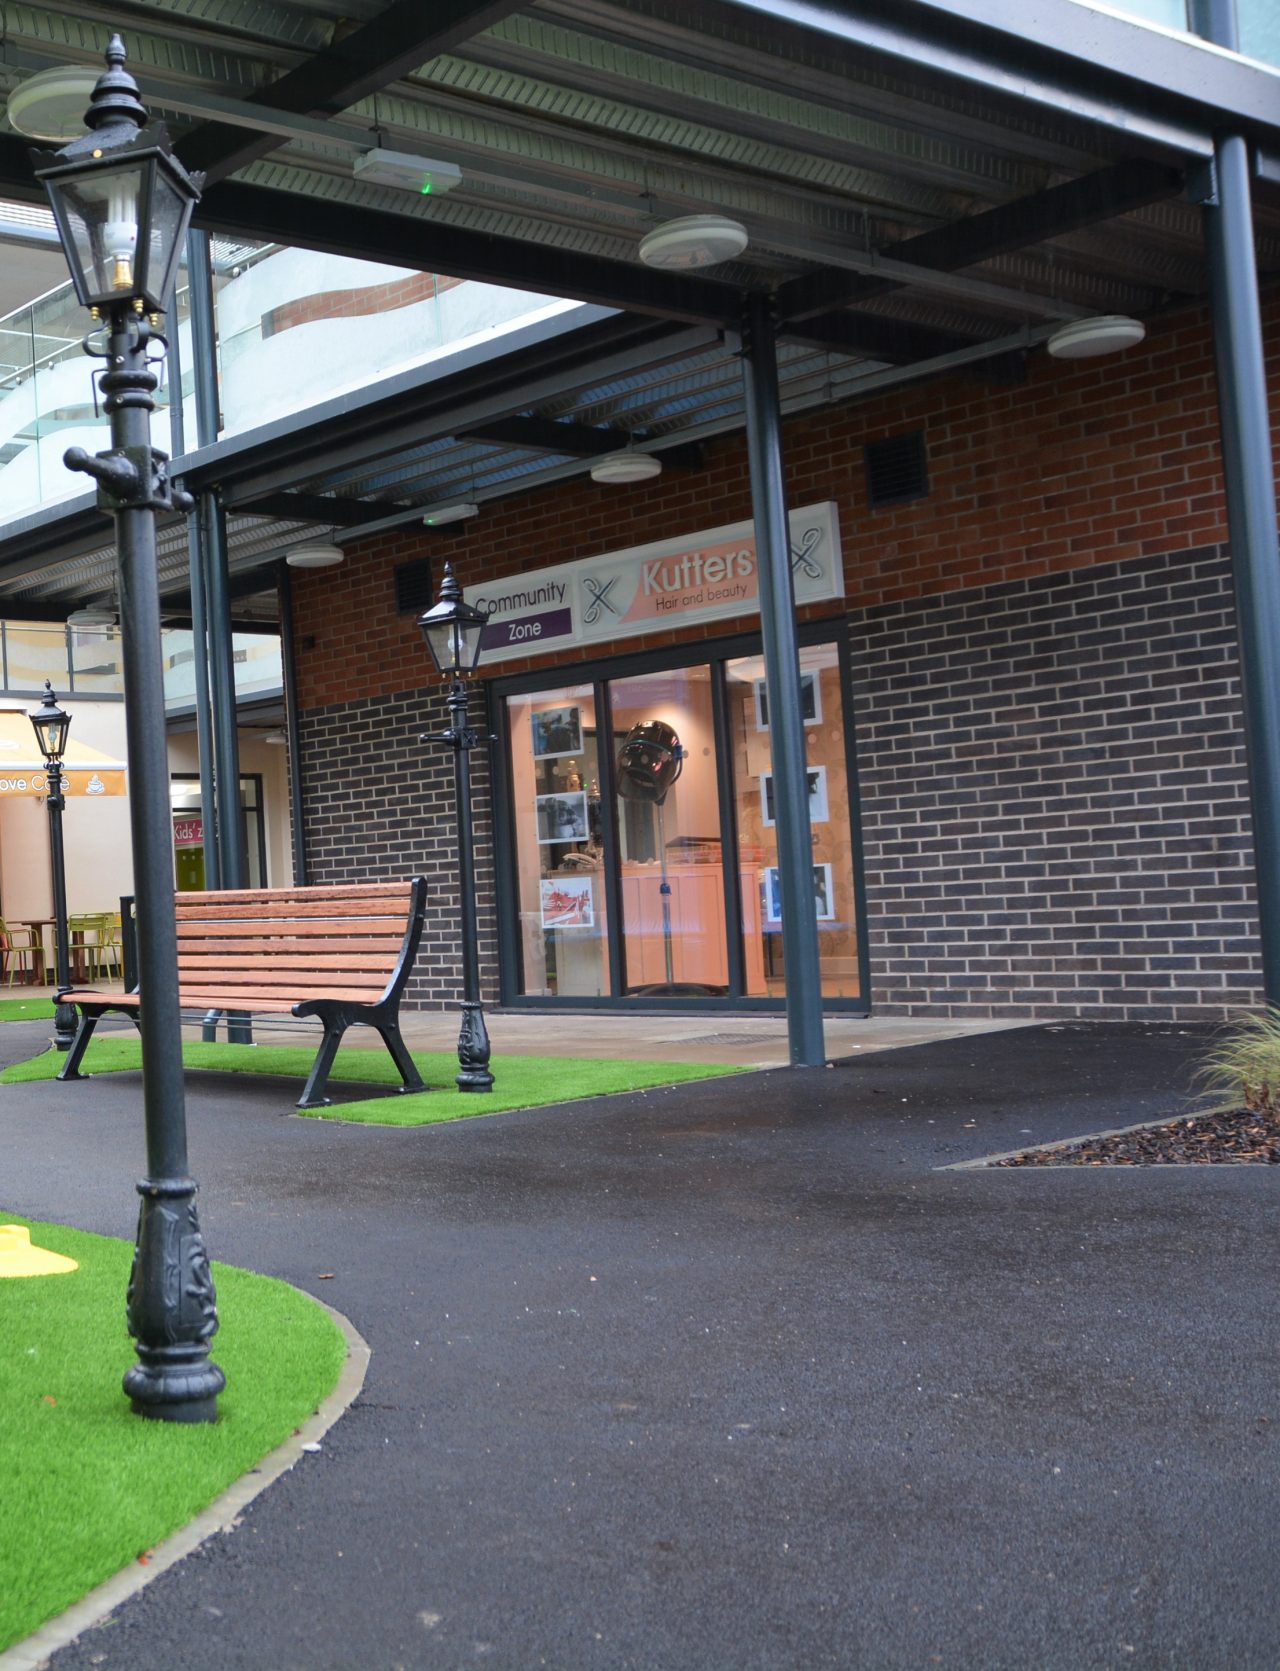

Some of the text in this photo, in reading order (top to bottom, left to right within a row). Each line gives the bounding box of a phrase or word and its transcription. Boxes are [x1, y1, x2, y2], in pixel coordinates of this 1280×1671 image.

[642, 549, 753, 597] Kutters
[475, 581, 566, 616] Community
[656, 584, 748, 611] Hair and beauty
[509, 621, 542, 641] Zone
